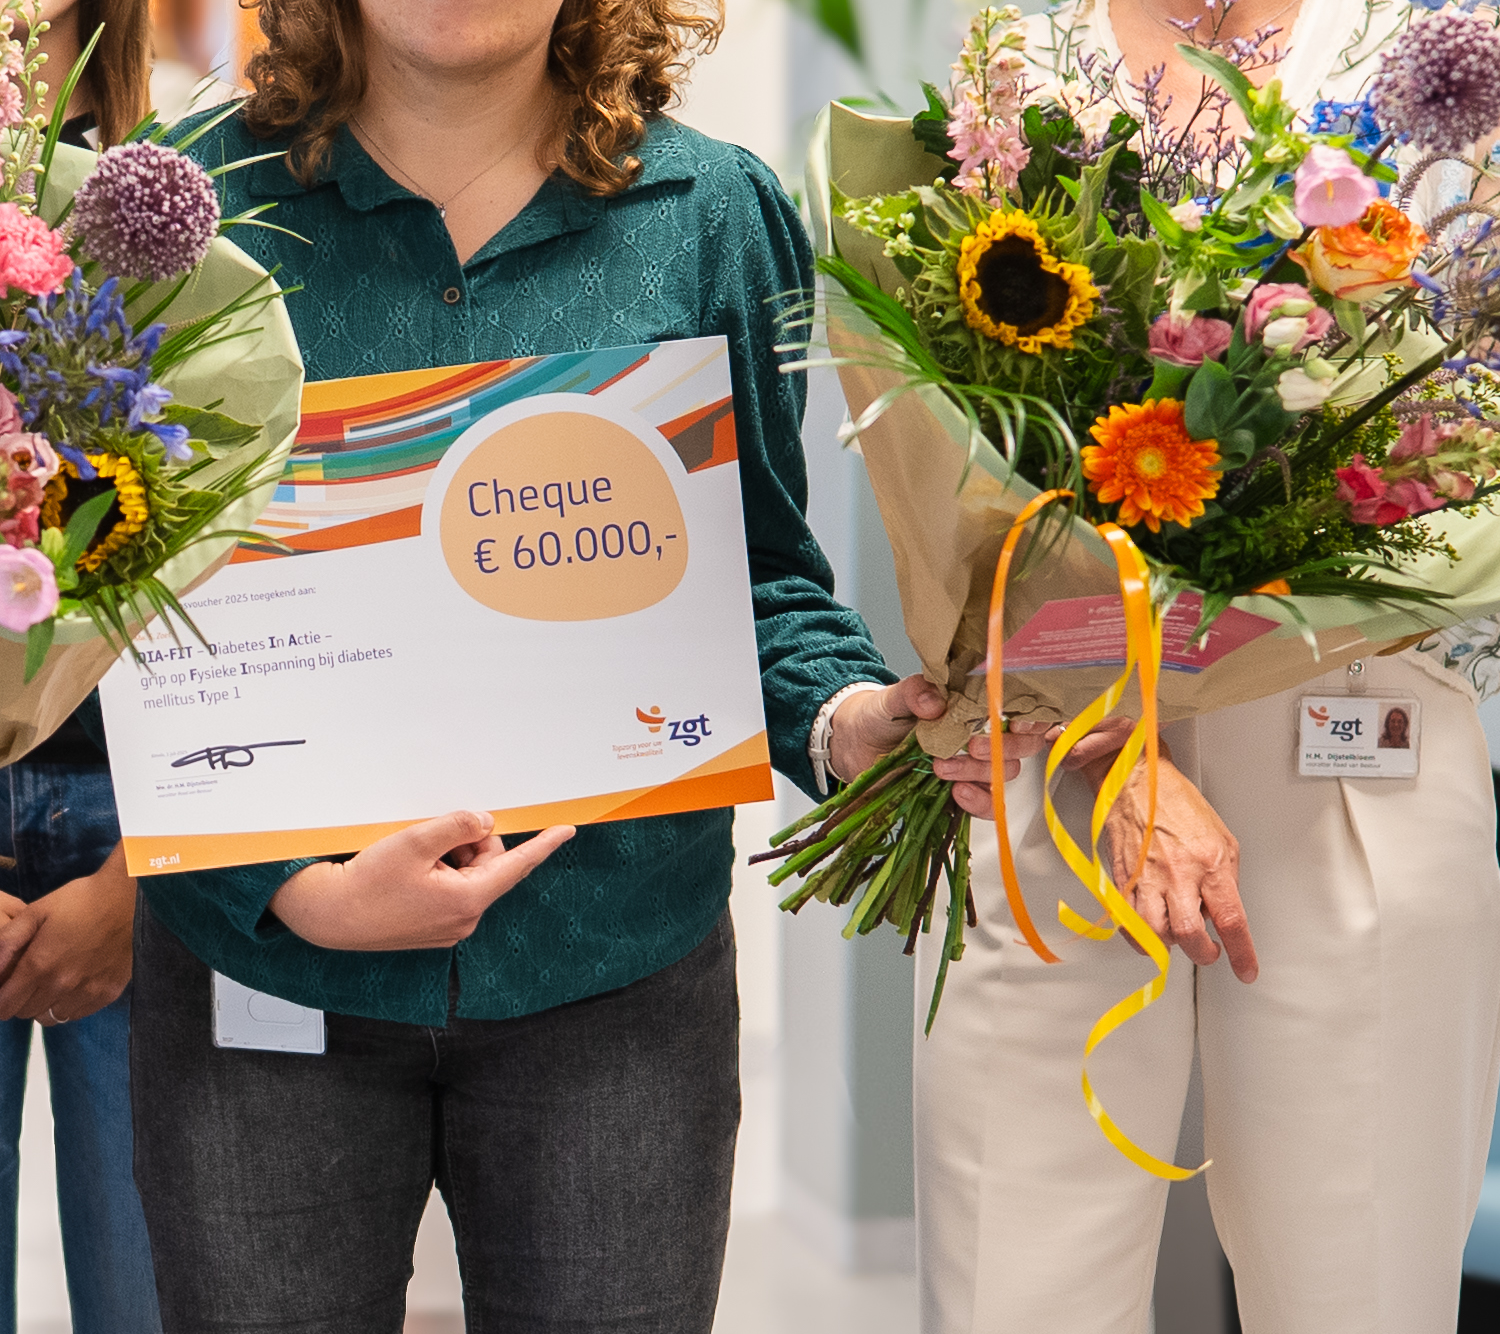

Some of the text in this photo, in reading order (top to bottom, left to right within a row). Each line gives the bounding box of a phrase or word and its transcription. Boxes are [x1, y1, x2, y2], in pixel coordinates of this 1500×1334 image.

[469, 477, 612, 517] Cheque
[474, 521, 677, 574] € 60.000,-
[225, 593, 248, 604] 2025
[250, 588, 296, 604] toegekend
[298, 587, 316, 595] aan:
[208, 639, 265, 656] Diabetes
[268, 635, 285, 649] In
[288, 631, 321, 647] Actie
[140, 647, 393, 690] grip op Fysieke Inspanning bij diabetes
[143, 686, 241, 709] mellitus Type 1
[668, 713, 712, 746] zgt
[1330, 718, 1364, 742] zgt
[149, 853, 180, 868] zgt.nl
